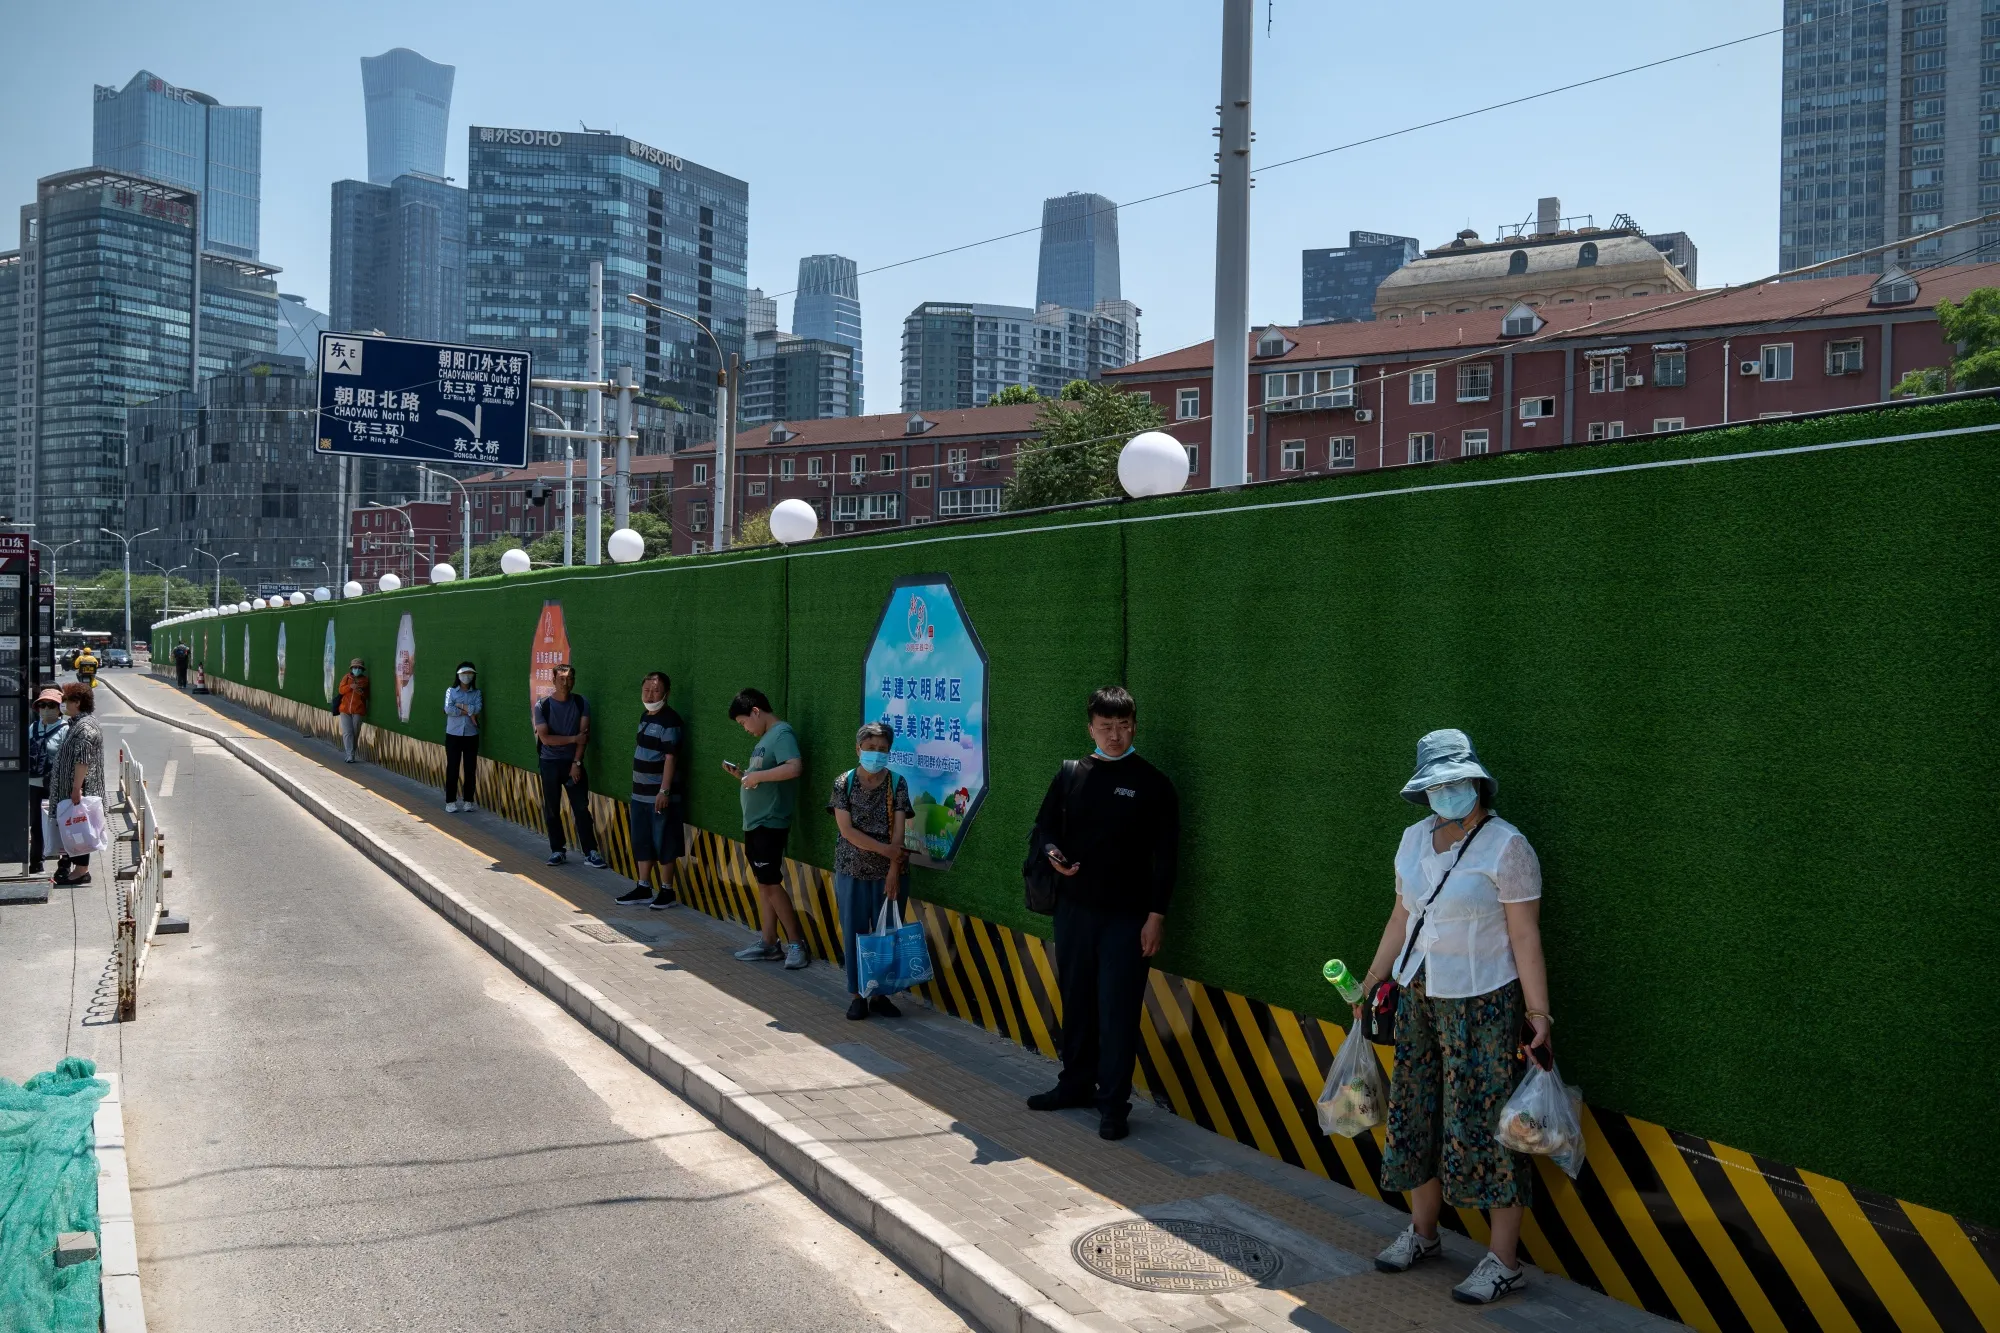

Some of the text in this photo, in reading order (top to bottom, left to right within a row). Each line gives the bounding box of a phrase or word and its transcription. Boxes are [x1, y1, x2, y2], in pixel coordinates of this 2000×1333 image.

[95, 85, 116, 102] FFC
[165, 83, 195, 106] FFC
[480, 127, 562, 147] 朝外SOHO
[629, 140, 683, 172] 朝外SOHO
[330, 342, 356, 358] 东 E
[438, 349, 522, 375] 朝阳门外大街
[438, 368, 521, 385] CHAOYANGMEN Outer St
[438, 380, 520, 399] (东三环 京广桥)
[334, 386, 420, 412] 朝阳北路
[334, 406, 420, 422] CHAOYANG North Rd
[348, 420, 405, 437] (东三环)
[370, 436, 386, 444] Ring
[454, 437, 500, 455] 东大桥
[479, 453, 499, 462] Bridge
[0, 537, 24, 548] 口东
[881, 676, 961, 703] 共建文明城区
[881, 713, 961, 743] 共享美好生活
